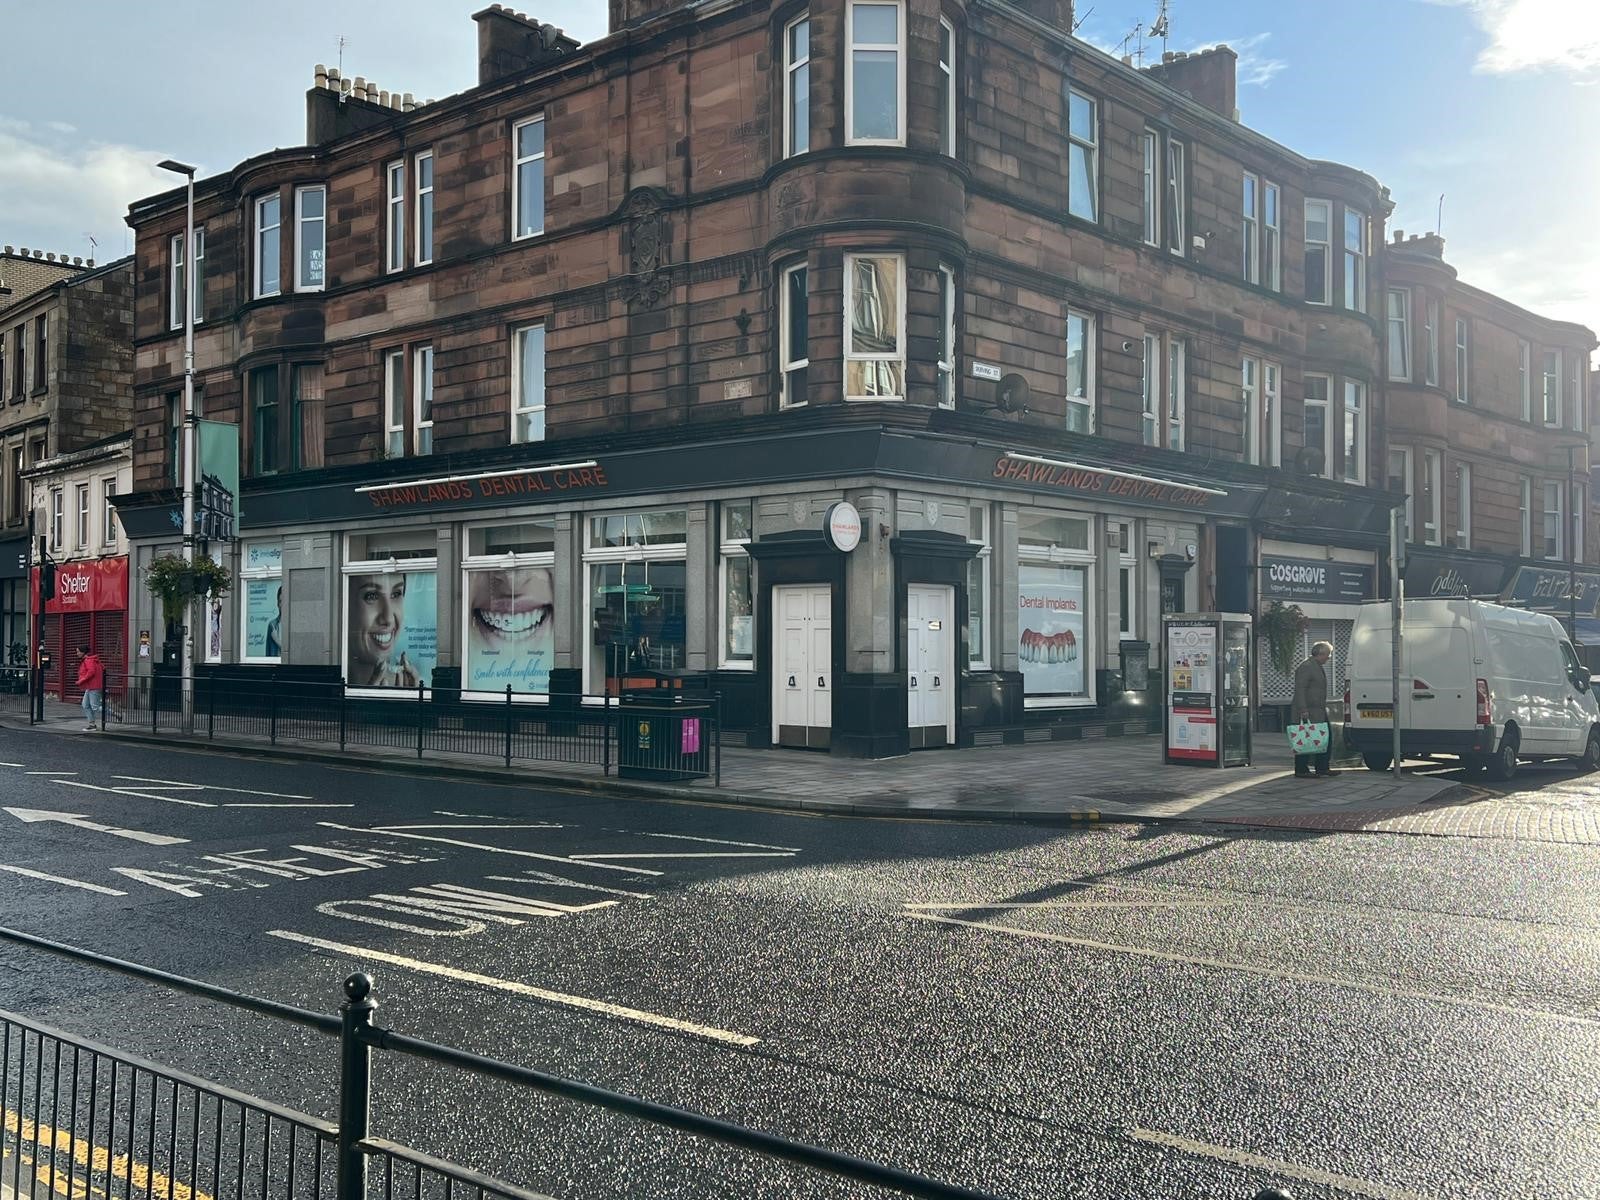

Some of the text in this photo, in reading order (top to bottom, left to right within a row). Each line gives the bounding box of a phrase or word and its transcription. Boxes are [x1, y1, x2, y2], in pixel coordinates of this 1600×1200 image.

[368, 466, 608, 507] SHAWLANDS DENTAL CARE
[992, 456, 1209, 506] SHAWLANDS DENTAL CARE
[61, 572, 91, 594] Shelter
[1269, 563, 1326, 585] COSGROVE
[1019, 595, 1077, 610] Dental Implants
[474, 660, 496, 681] Smile
[496, 659, 516, 678] with
[314, 870, 656, 937] ONLY
